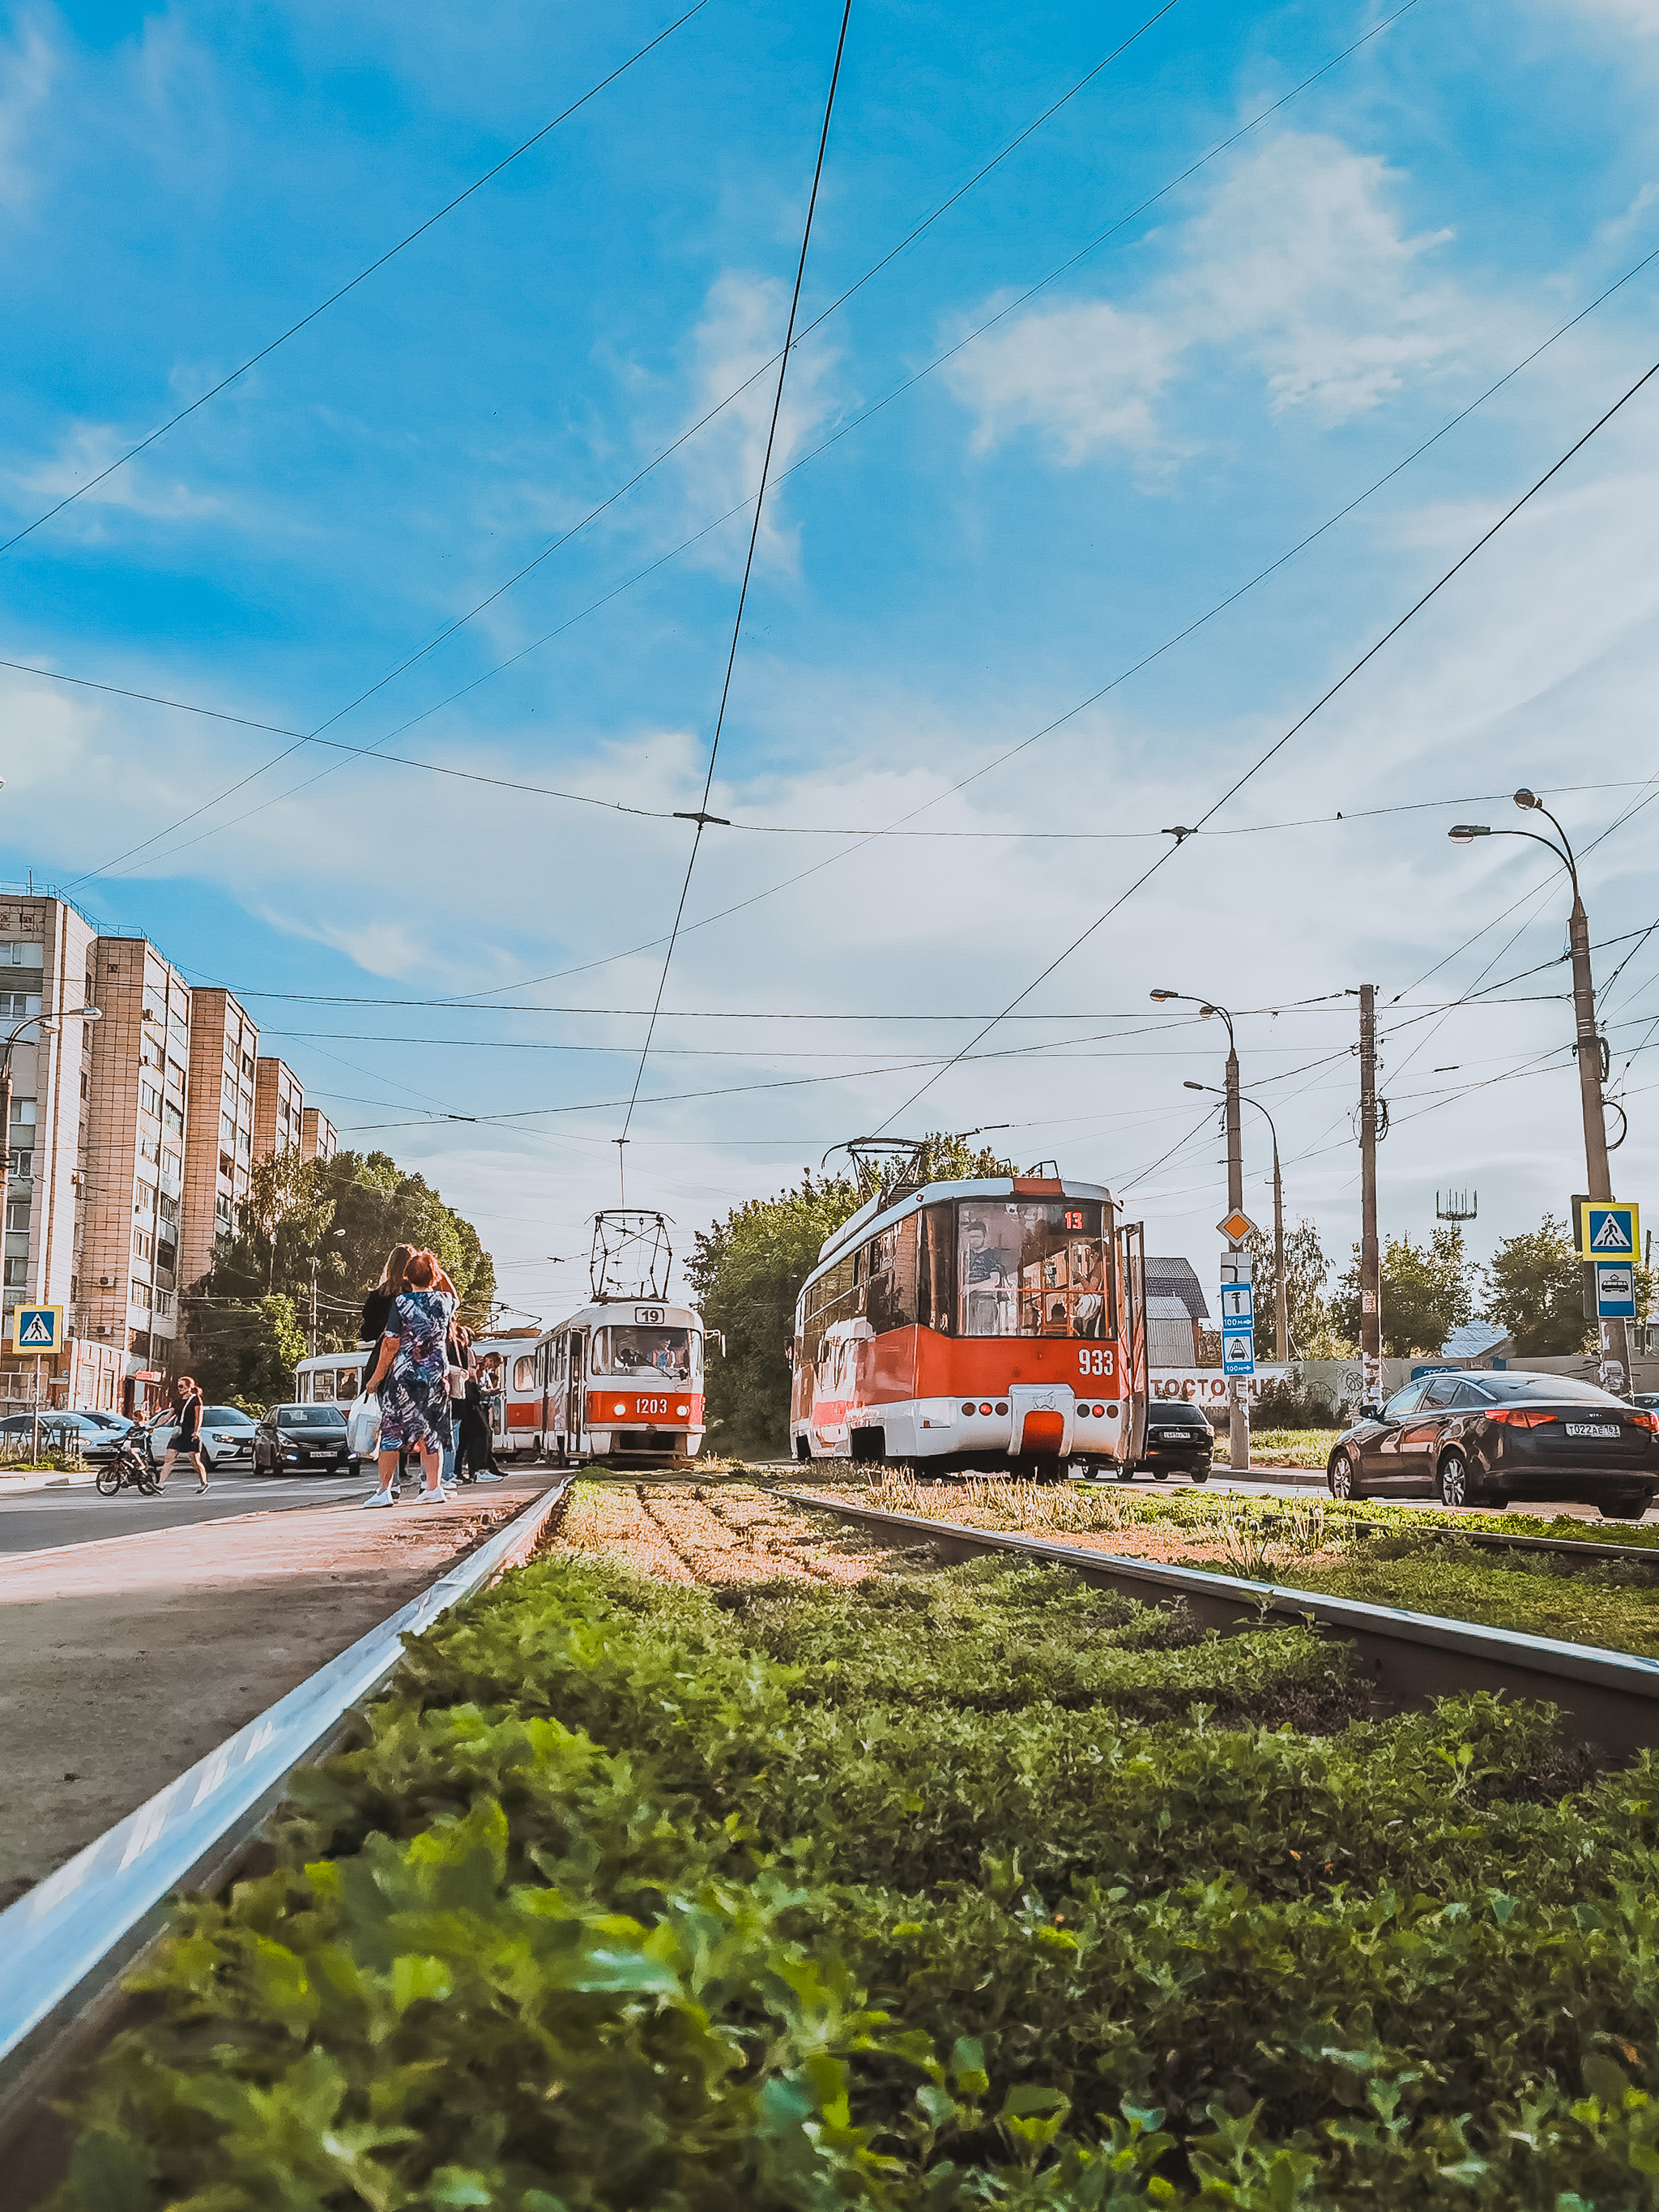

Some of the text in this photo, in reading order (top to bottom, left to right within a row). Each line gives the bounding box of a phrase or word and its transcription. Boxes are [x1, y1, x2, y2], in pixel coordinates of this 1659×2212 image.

[1064, 1211, 1083, 1230] 13
[642, 1309, 659, 1322] 19
[1078, 1348, 1114, 1376] 933
[636, 1398, 667, 1414] 1203
